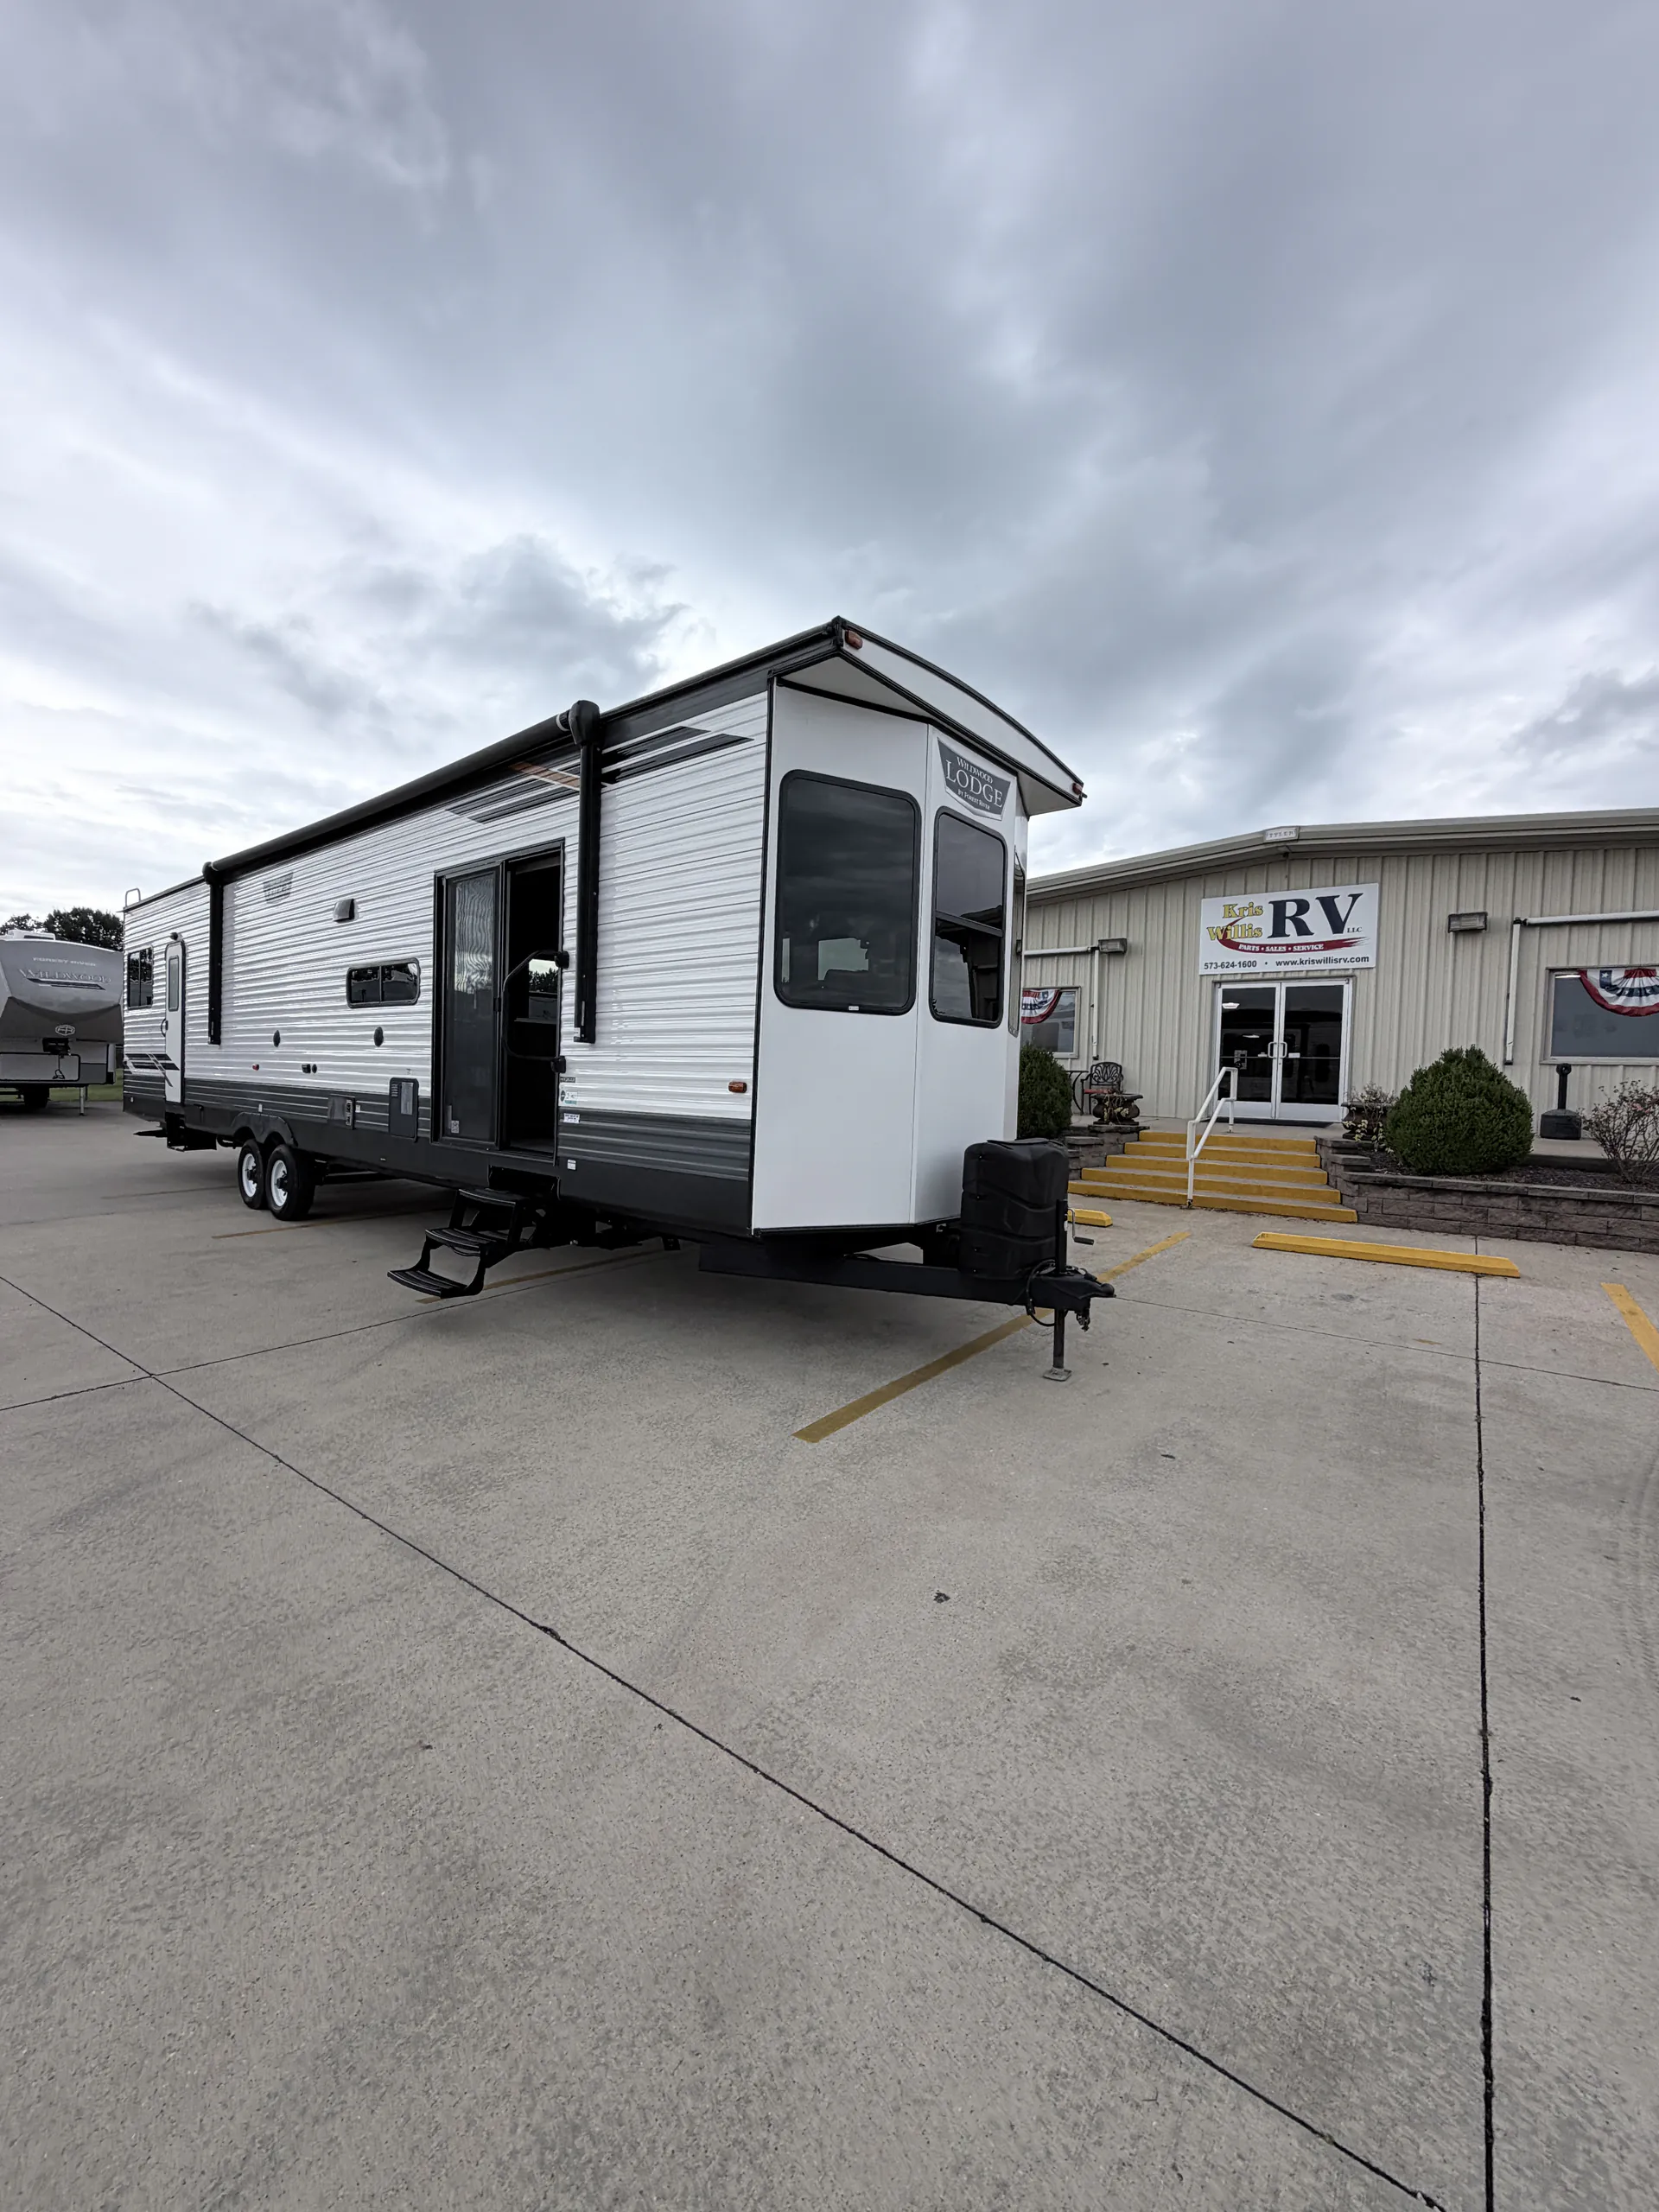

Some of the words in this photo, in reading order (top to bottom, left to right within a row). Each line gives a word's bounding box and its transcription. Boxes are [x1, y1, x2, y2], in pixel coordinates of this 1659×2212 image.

[957, 756, 994, 784] WILDWOOD
[945, 760, 1003, 808] LODGE
[1222, 901, 1264, 918] Kris
[1267, 893, 1363, 939] RV
[1206, 924, 1263, 941] Willis
[1204, 960, 1257, 969] 573-624-1600
[1275, 955, 1370, 967] www.kriswillisrv.com
